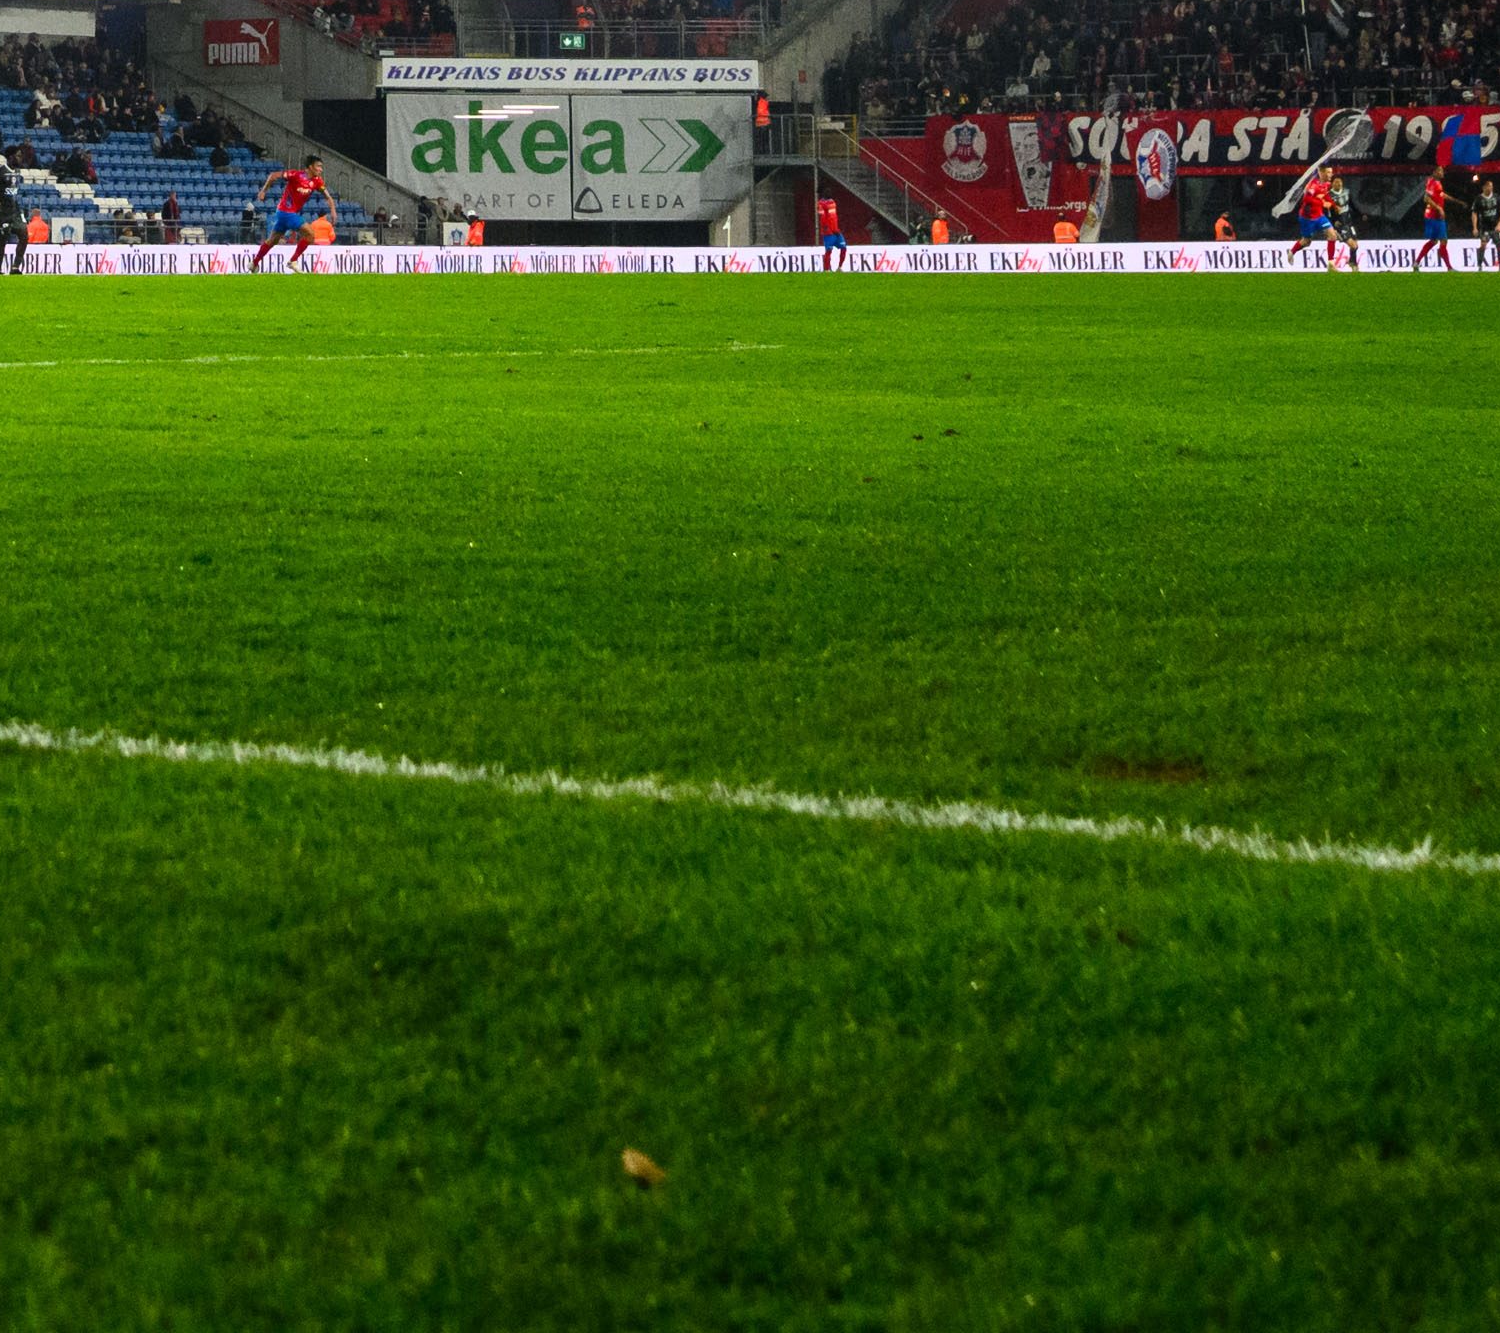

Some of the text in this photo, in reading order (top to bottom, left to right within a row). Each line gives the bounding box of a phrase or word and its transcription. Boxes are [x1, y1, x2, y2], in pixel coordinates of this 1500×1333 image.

[208, 41, 261, 64] PUMA
[386, 65, 753, 82] KLIPPANS BUSS KLIPPANS BUSS
[410, 100, 628, 175] akea
[1227, 108, 1310, 162] STÅ
[463, 193, 685, 209] PART OF ELEDA
[76, 253, 99, 274] EKE
[120, 249, 177, 274] MÖBLER
[849, 253, 877, 271] EKE
[905, 249, 978, 271] MÖBLER
[990, 251, 1019, 270] EKE
[1048, 248, 1124, 270] MÖBLER
[1143, 250, 1174, 269] EKE
[1204, 245, 1283, 269] MÖBLER
